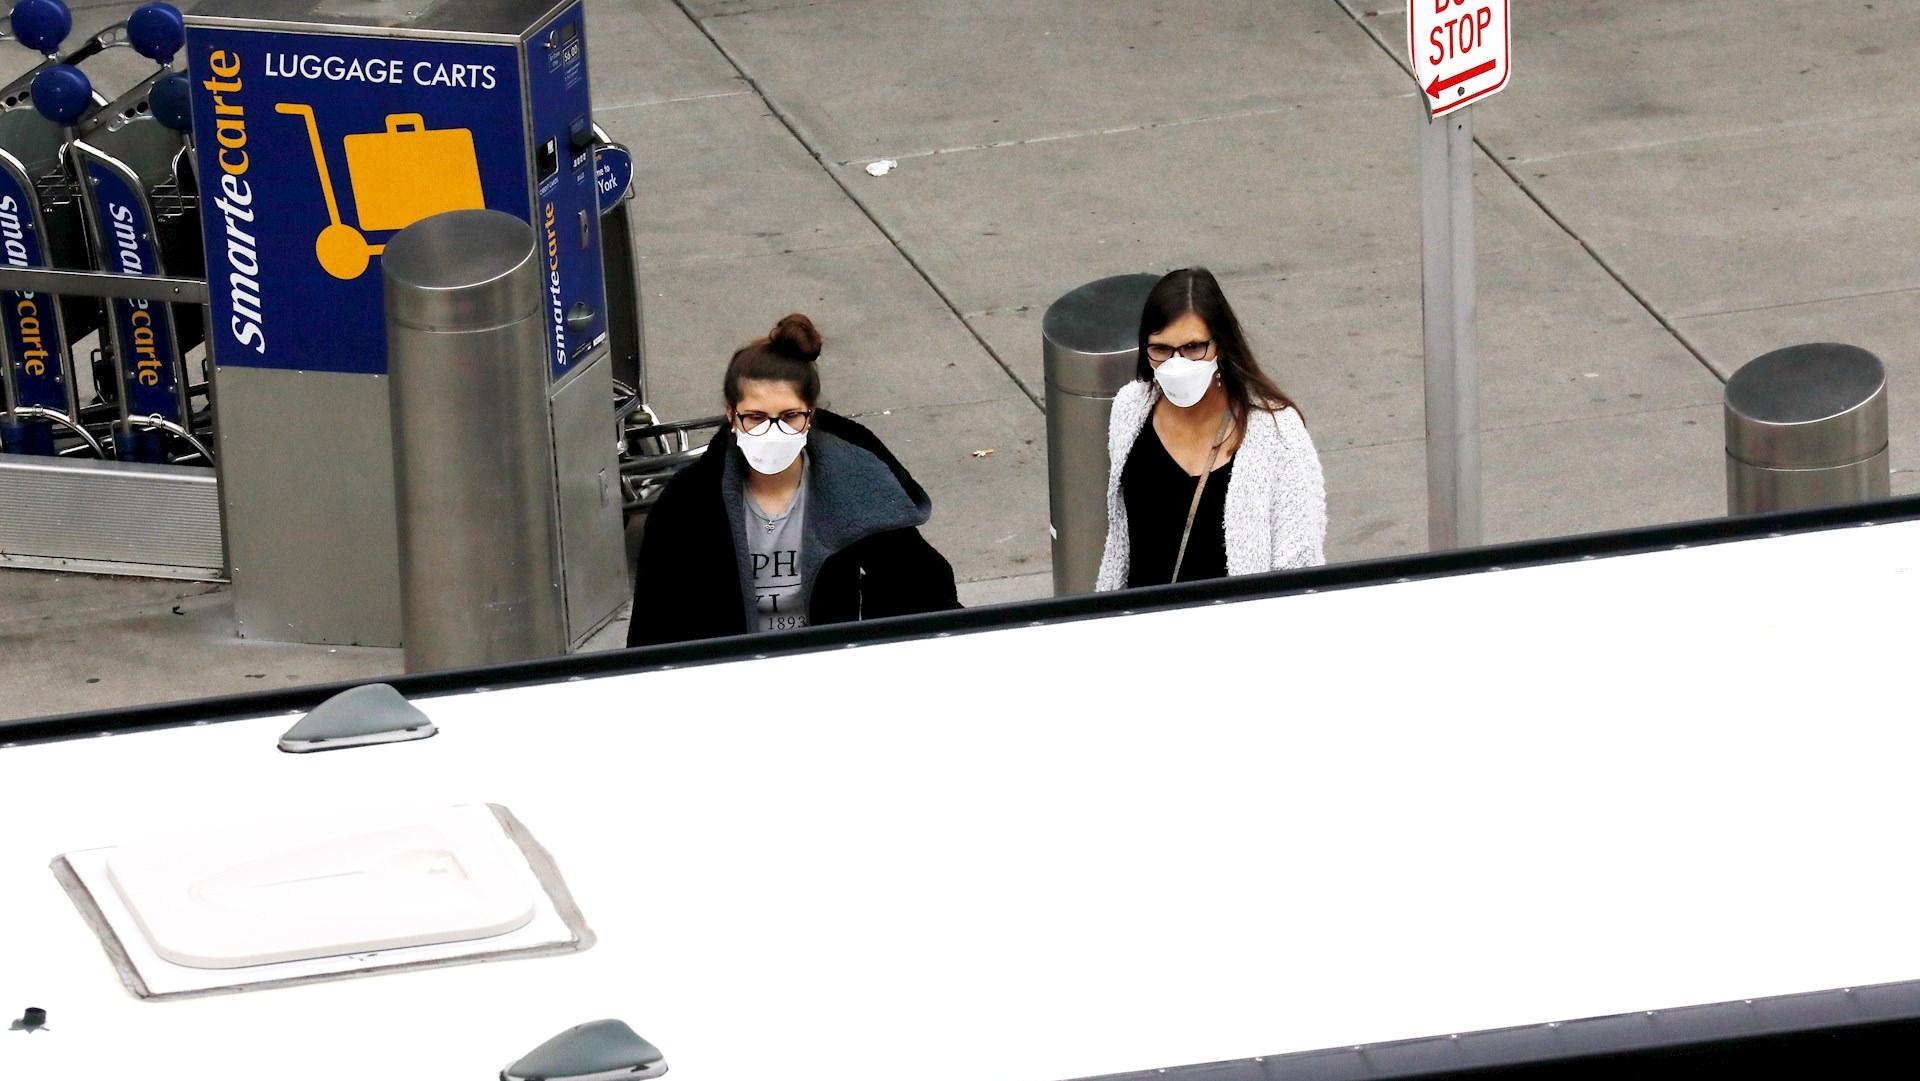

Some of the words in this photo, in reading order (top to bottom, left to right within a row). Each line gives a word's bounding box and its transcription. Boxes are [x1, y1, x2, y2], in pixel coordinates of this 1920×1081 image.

[1429, 6, 1491, 66] STOP
[265, 52, 403, 84] LUGGAGE
[413, 61, 496, 90] CARTS
[202, 48, 266, 354] smartecarte
[598, 173, 618, 194] York
[769, 616, 806, 630] 1893
